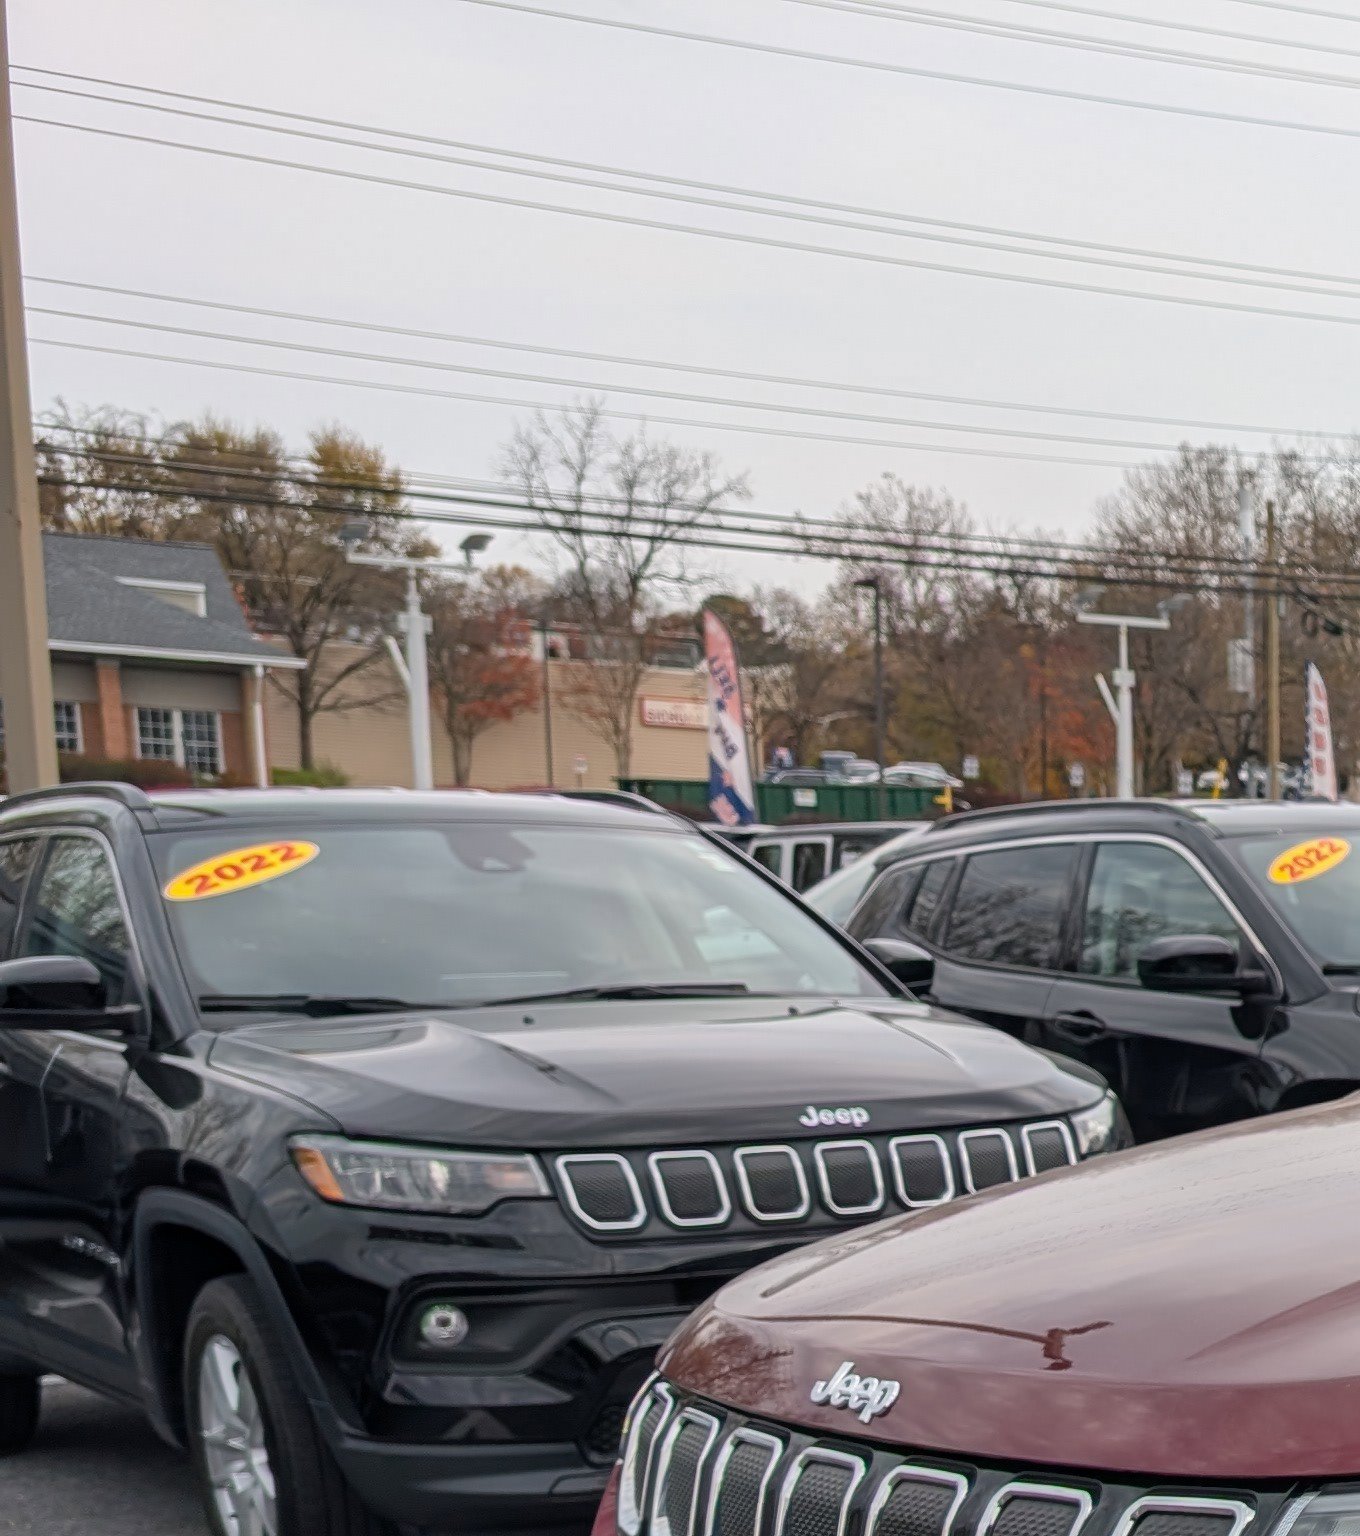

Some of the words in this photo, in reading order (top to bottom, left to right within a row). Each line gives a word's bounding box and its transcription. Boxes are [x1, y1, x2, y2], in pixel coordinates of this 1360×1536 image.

[184, 845, 305, 896] 2022
[1279, 839, 1344, 878] 2022
[799, 1105, 870, 1128] Jeep
[810, 1361, 900, 1424] Jeep
